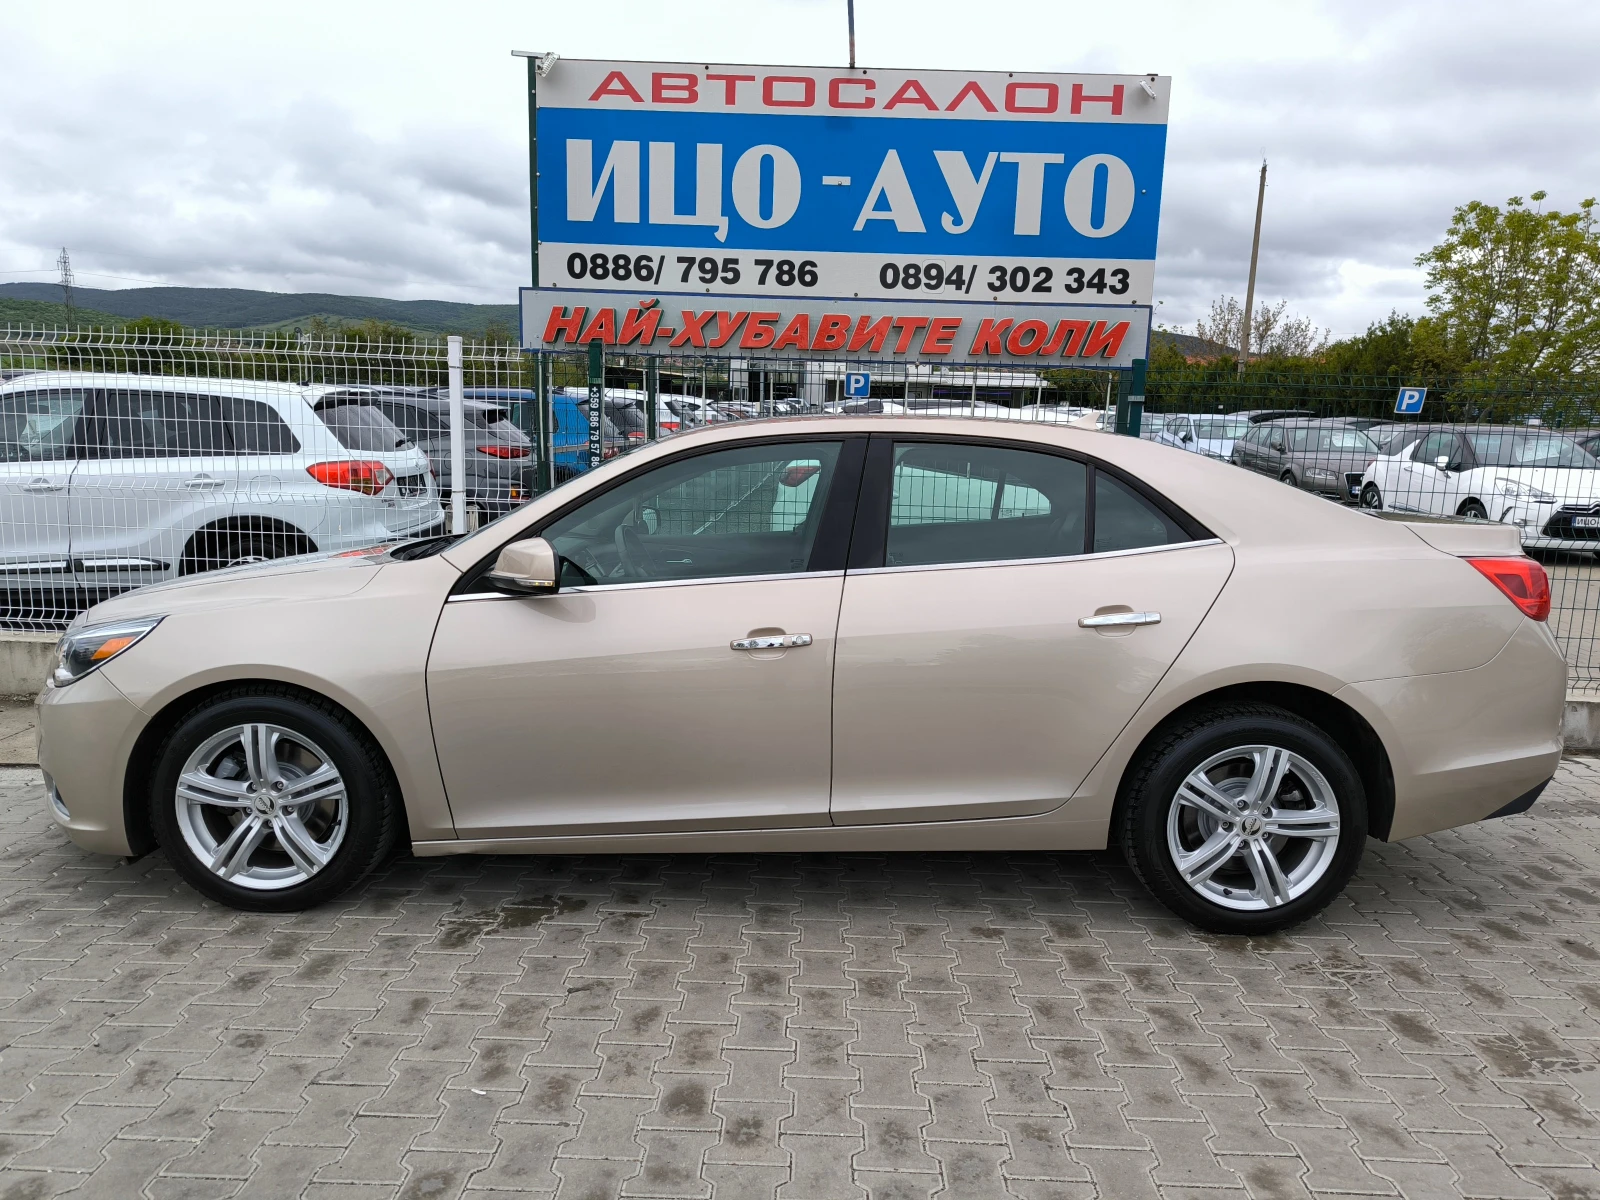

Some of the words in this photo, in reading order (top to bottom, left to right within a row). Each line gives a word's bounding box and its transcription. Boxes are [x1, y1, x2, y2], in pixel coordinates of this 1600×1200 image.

[588, 71, 1124, 115] АВТОСАЛОН
[566, 252, 665, 284] 0886/
[676, 256, 741, 284] 795
[754, 258, 819, 287] 786
[879, 262, 978, 294] 0894/
[987, 265, 1053, 293] 302
[1064, 267, 1130, 295] 343
[541, 297, 963, 356] НАЙ-ХУБАВИТЕ
[969, 317, 1131, 358] КОЛИ
[850, 375, 865, 394] P
[590, 386, 599, 409] +359
[1401, 391, 1420, 410] P
[590, 411, 599, 427] 886
[590, 430, 599, 441] 79
[590, 443, 600, 454] 57
[591, 456, 600, 467] 86
